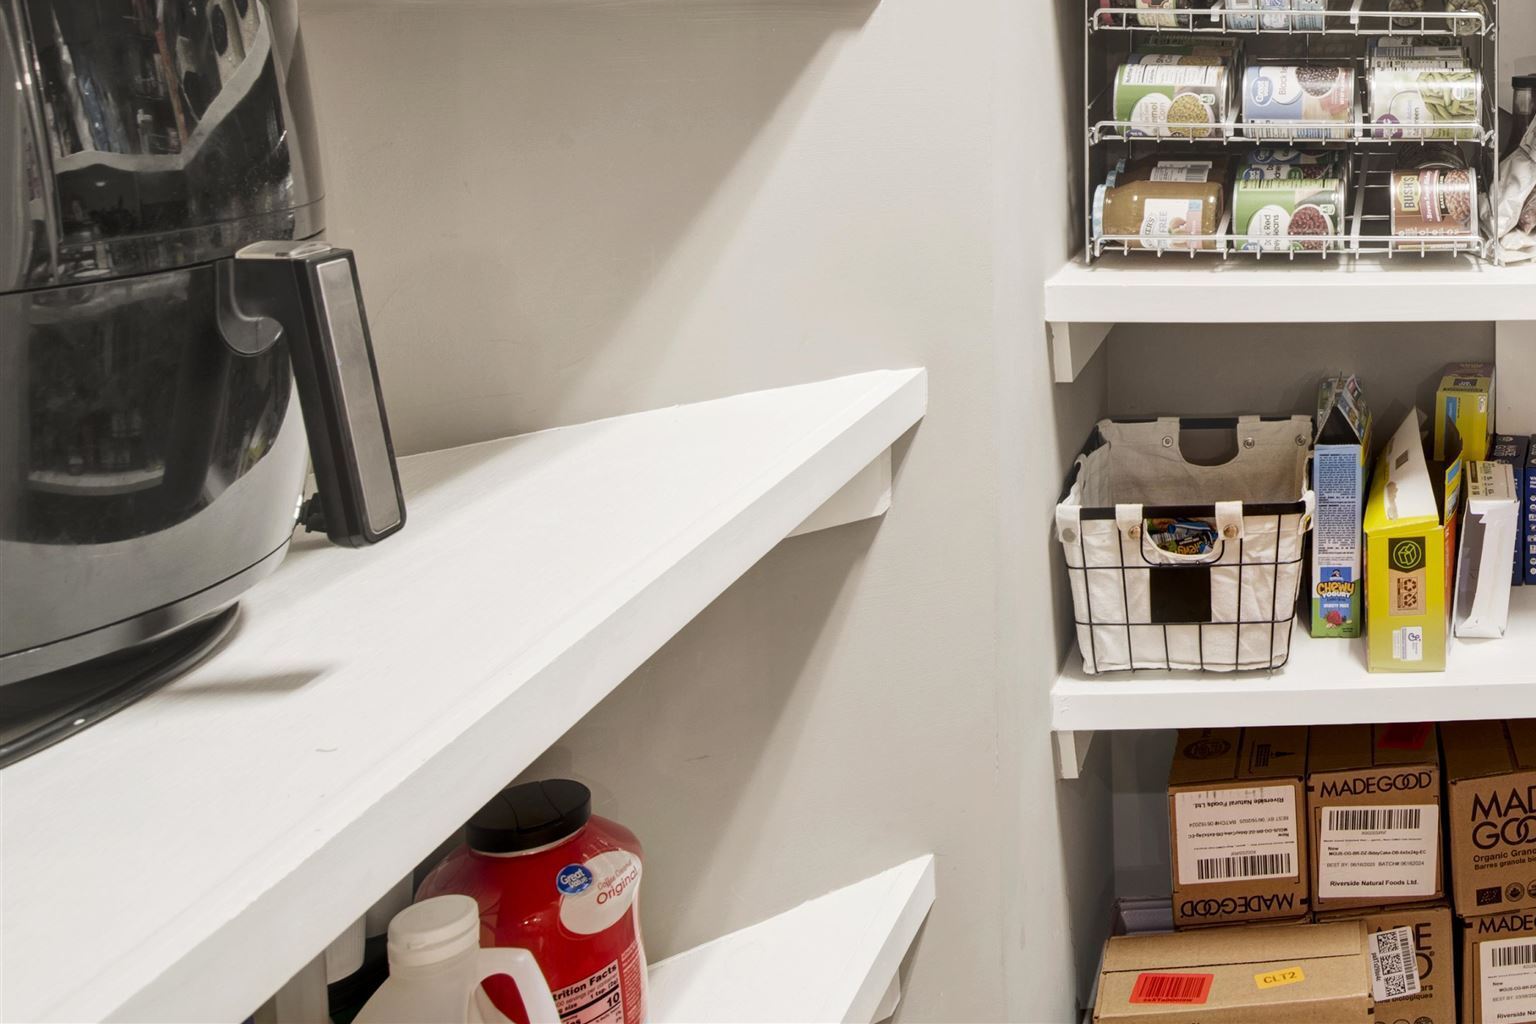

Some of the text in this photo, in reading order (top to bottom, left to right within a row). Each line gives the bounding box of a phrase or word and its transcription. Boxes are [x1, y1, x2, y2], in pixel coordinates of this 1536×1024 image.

[1402, 175, 1416, 210] BUSH'S
[1317, 580, 1355, 595] CHEWY
[1321, 591, 1351, 599] YOGURT
[1320, 770, 1433, 797] MADEGOOD
[1473, 852, 1504, 864] Organic
[1474, 861, 1500, 871] Barres
[1501, 858, 1525, 870] granola
[560, 868, 586, 884] Great
[1362, 879, 1384, 887] Natural
[596, 865, 638, 905] Original
[1180, 892, 1295, 918] MADEGOOD
[589, 963, 618, 987] Facts
[1262, 971, 1299, 986] CLT2
[606, 992, 621, 1008] 10
[1497, 1010, 1527, 1019] Riverside
